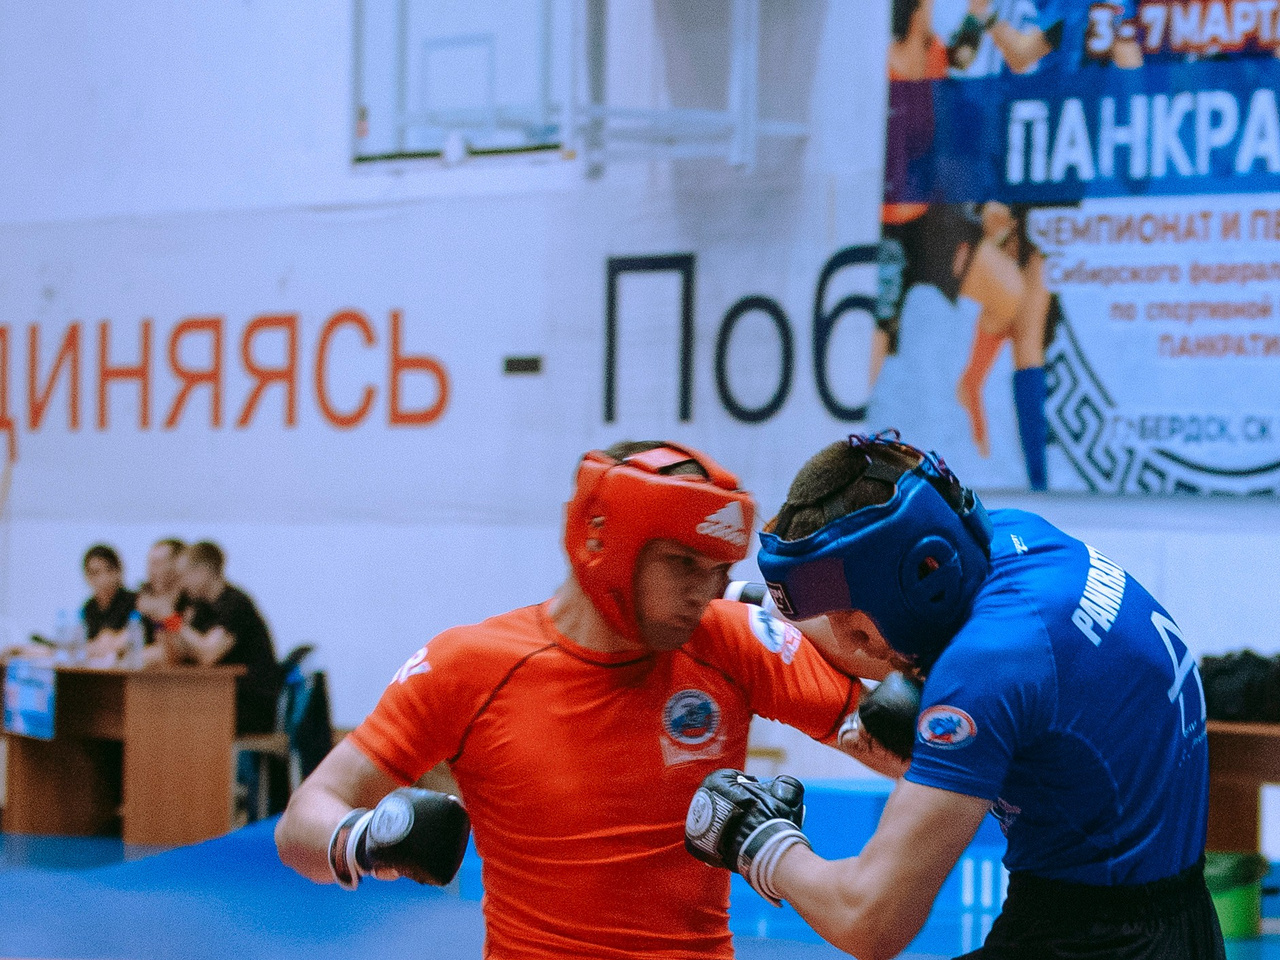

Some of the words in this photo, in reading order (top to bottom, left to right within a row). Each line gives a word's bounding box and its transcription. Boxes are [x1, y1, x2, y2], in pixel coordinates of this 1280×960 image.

[1033, 209, 1213, 245] ЧЕМПИОНАТ
[1221, 209, 1241, 241] И
[1048, 258, 1181, 287] Сибирского
